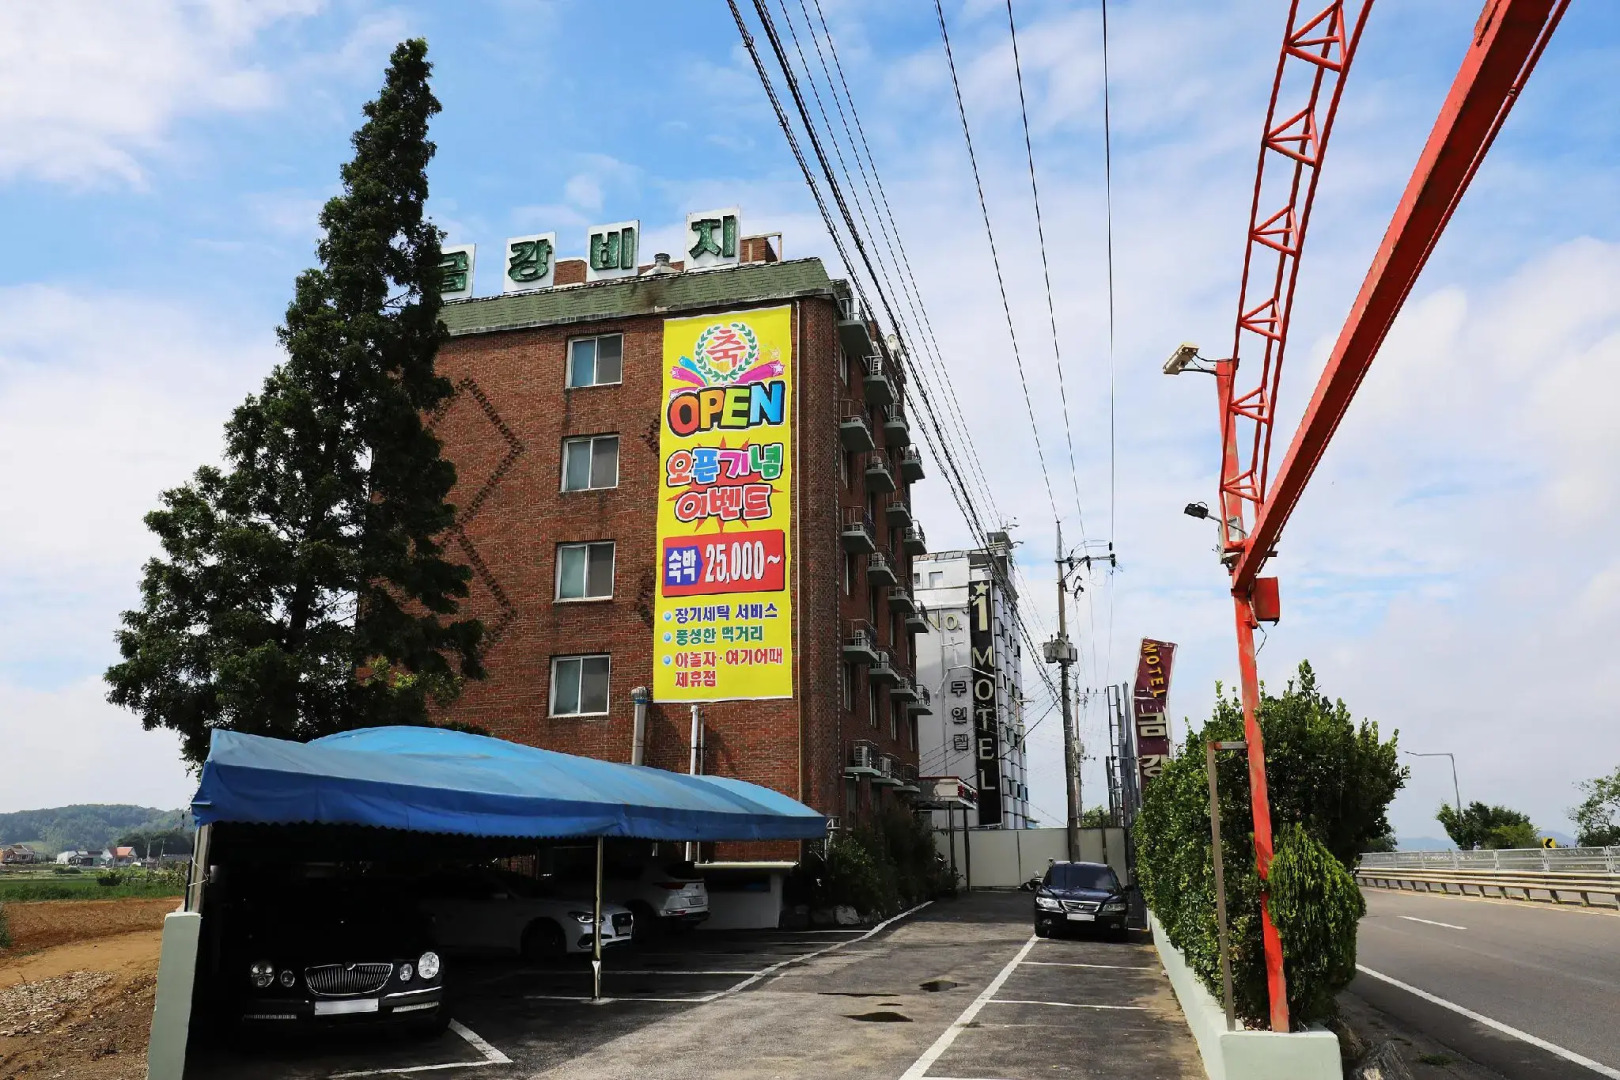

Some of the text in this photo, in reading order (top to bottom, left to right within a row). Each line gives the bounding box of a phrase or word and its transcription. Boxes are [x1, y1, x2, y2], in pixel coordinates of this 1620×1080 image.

[706, 329, 746, 368] 축
[668, 382, 786, 437] OPEN
[667, 444, 784, 487] 오픈기념
[676, 485, 772, 521] 이벤트
[668, 549, 697, 583] 숙박
[675, 603, 778, 625] 장기세탁 서비스
[675, 625, 763, 646] 풍성한 먹거리
[675, 671, 717, 688] 제휴점
[1143, 641, 1166, 698] MOTEL
[951, 681, 969, 751] 무인텔
[971, 646, 996, 790] MOTEL
